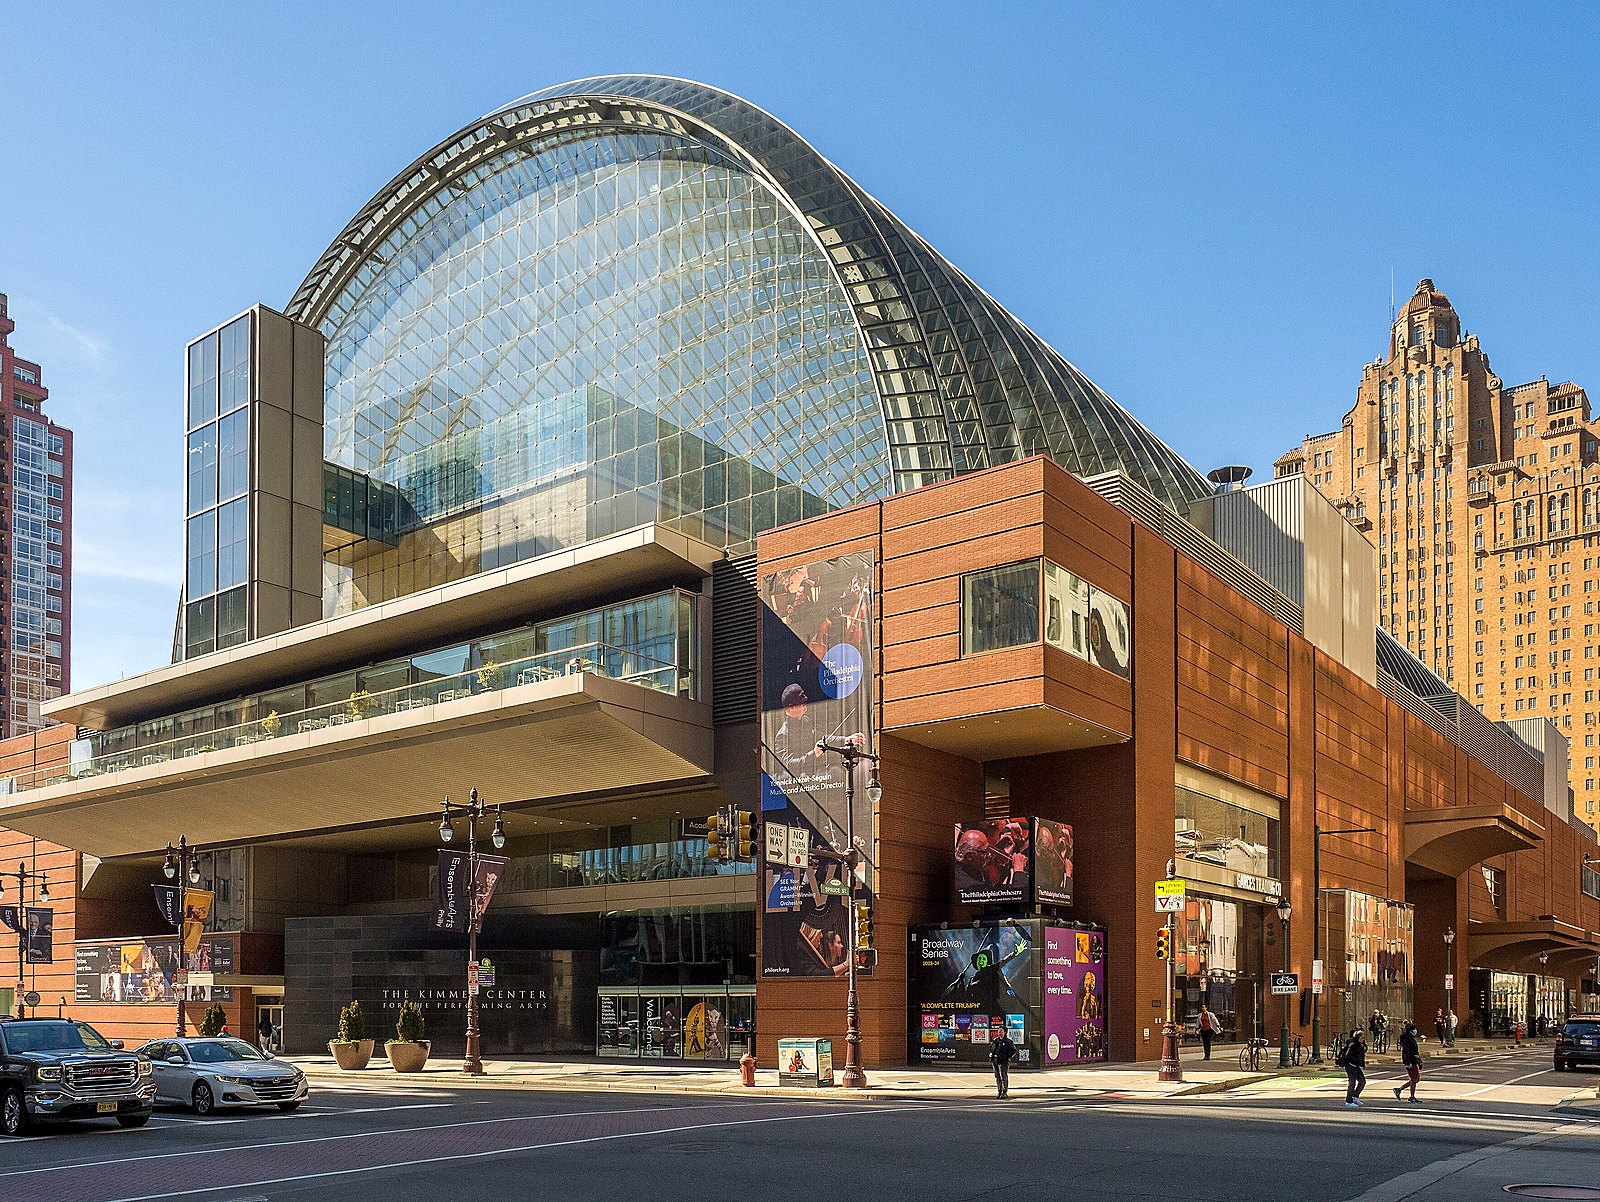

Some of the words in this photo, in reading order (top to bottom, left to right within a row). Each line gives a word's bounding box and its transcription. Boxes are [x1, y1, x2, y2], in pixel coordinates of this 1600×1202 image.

[823, 664, 861, 677] Philadelphia
[823, 675, 854, 686] Orchestra
[787, 786, 799, 794] and
[800, 784, 820, 792] Artistic
[820, 781, 845, 790] Director
[769, 826, 783, 838] ONE
[793, 830, 804, 841] NO
[769, 836, 784, 847] WAY
[791, 840, 806, 849] TURN
[797, 848, 807, 856] RED
[445, 857, 461, 929] EnsembleArts
[779, 891, 816, 900] Award-Winning
[435, 909, 445, 928] Philly
[922, 938, 964, 949] Broadway
[1047, 941, 1058, 950] Find
[921, 948, 949, 958] Series
[1047, 956, 1072, 968] something
[1053, 971, 1064, 981] love,
[382, 990, 410, 999] THE
[419, 990, 468, 999] KIMME
[486, 990, 547, 999] CENTER
[1047, 987, 1061, 996] every
[646, 998, 654, 1051] Welcome
